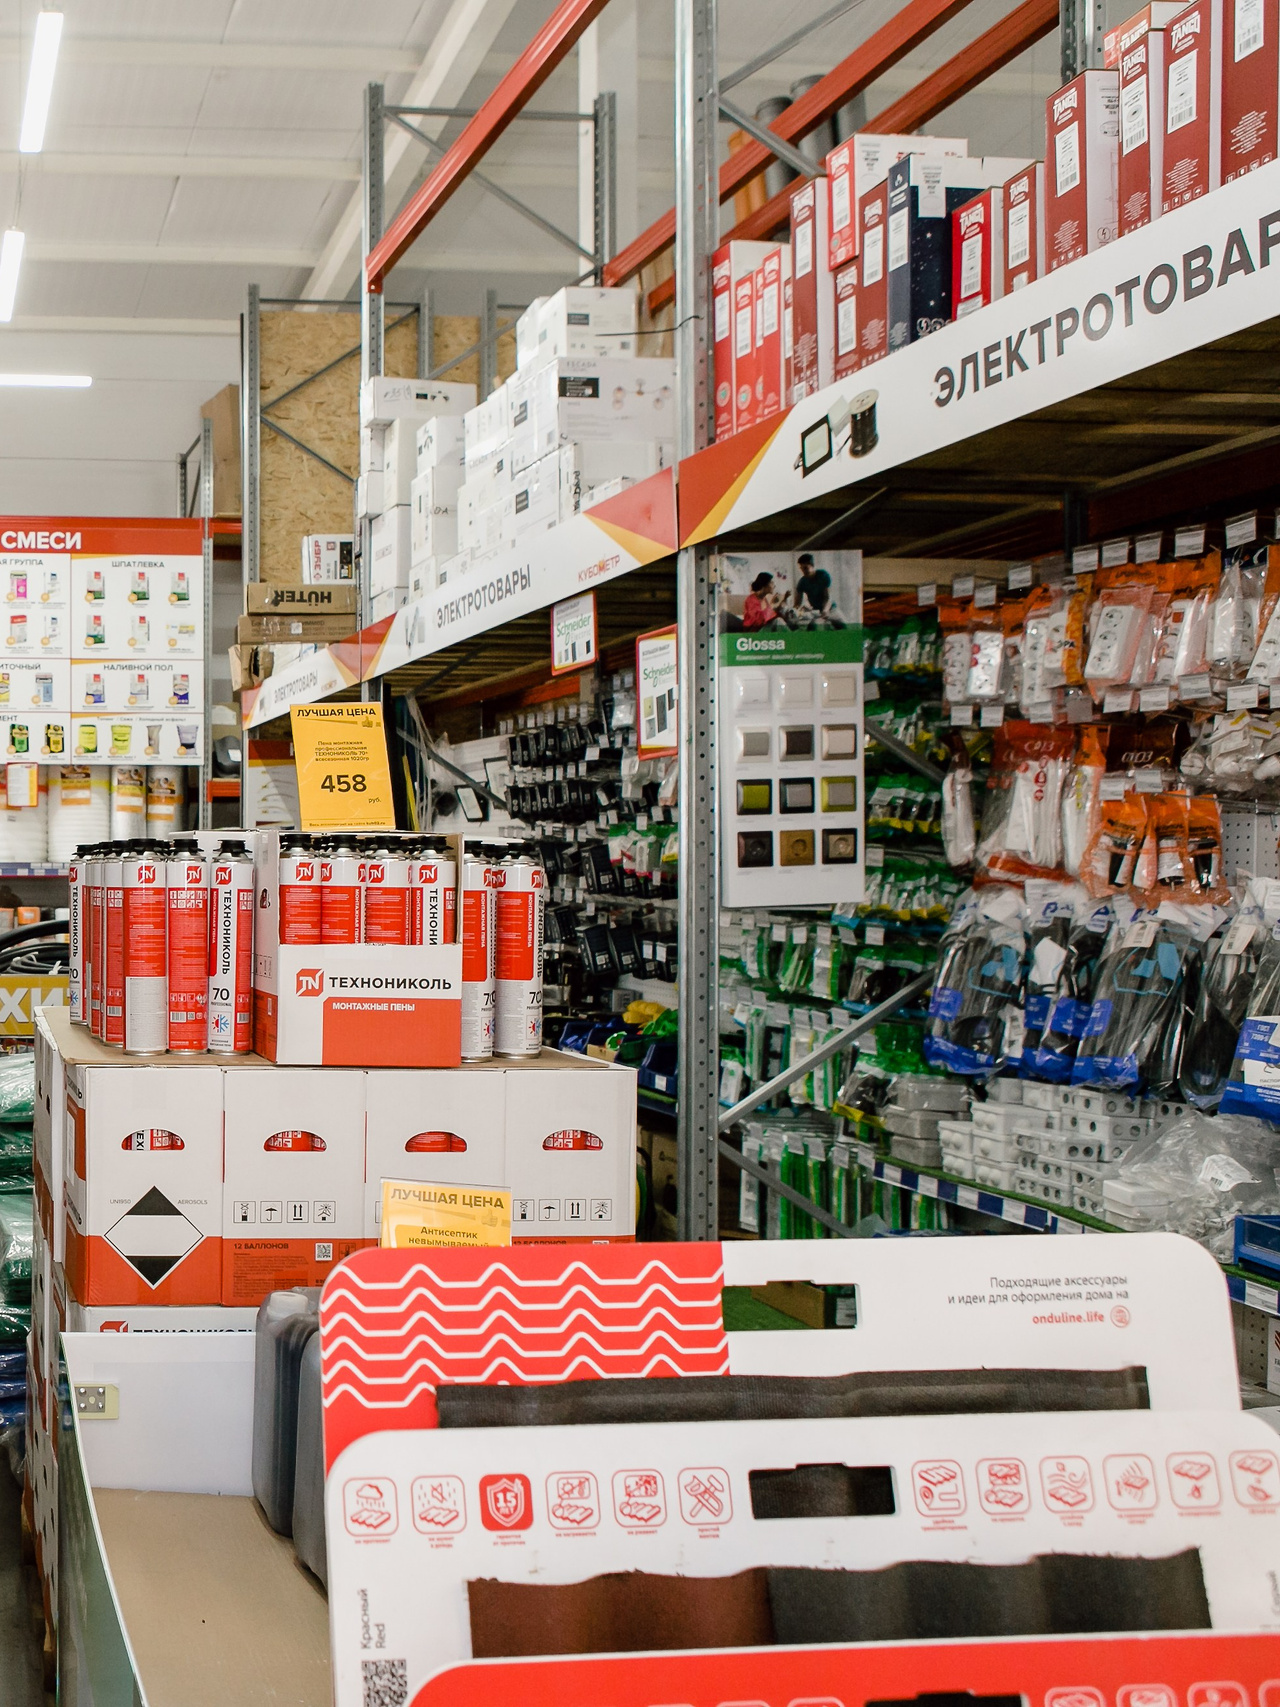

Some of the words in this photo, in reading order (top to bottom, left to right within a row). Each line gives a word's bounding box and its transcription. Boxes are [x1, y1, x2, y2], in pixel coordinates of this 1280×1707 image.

[1, 530, 82, 550] СМЕСИ
[314, 540, 322, 570] ЗУБР
[578, 555, 621, 582] КУБОМЕТР
[437, 563, 531, 628] ЭЛЕКТРОТОВАРЫ
[556, 614, 592, 640] Schneider
[736, 637, 786, 652] Glossa
[103, 663, 153, 672] НАЛИВНОЙ
[155, 664, 173, 672] ПОЛ
[297, 709, 344, 717] ЛУЧШАЯ
[347, 708, 376, 717] ЦЕНА
[321, 774, 367, 793] 458
[187, 866, 202, 884] TN
[216, 867, 232, 885] TN
[296, 862, 314, 881] TN
[368, 864, 384, 883] TN
[419, 865, 438, 883] TN
[223, 890, 232, 975] ТЕХНОНИКОЛЬ
[296, 968, 324, 997] TN
[329, 976, 452, 990] ТЕХНОНИКОЛЬ
[213, 988, 230, 1000] 70
[332, 1002, 389, 1011] МОНТАЖНЫЕ
[390, 1003, 415, 1011] ПЕНЫ
[391, 1188, 458, 1204] ЛУЧШАЯ
[462, 1194, 505, 1209] ЦЕНА
[420, 1226, 478, 1240] Антисептик
[990, 1276, 1061, 1289] Подходящие
[1064, 1275, 1128, 1287] аксессуары
[948, 1296, 955, 1304] и
[958, 1295, 986, 1305] идеи
[988, 1293, 1008, 1305] для
[1011, 1292, 1083, 1305] оформления
[1085, 1291, 1113, 1301] дома
[1116, 1290, 1129, 1299] на
[1032, 1311, 1105, 1325] onduline.life
[495, 1492, 517, 1507] 15
[357, 1588, 371, 1650] Красный
[376, 1623, 386, 1649] Red
